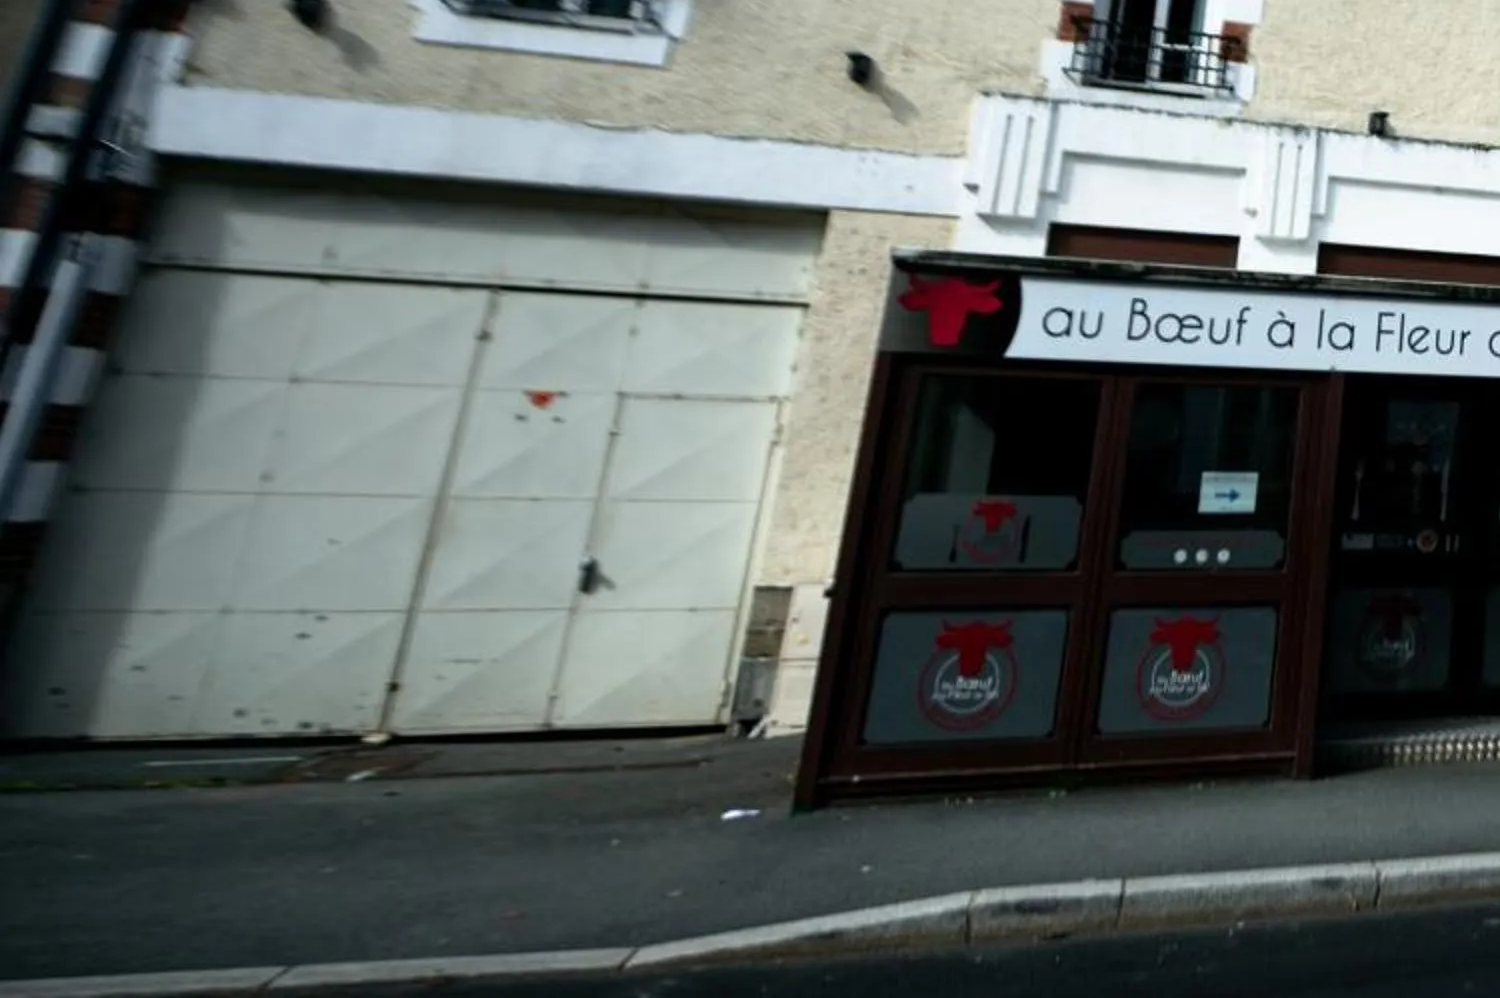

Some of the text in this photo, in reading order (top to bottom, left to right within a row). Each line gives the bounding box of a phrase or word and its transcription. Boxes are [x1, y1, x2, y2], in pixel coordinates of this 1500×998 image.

[1042, 306, 1104, 339] au
[1126, 297, 1251, 345] Bœuf
[1267, 310, 1296, 349] à
[1317, 308, 1356, 351] la
[1375, 311, 1471, 355] Fleur
